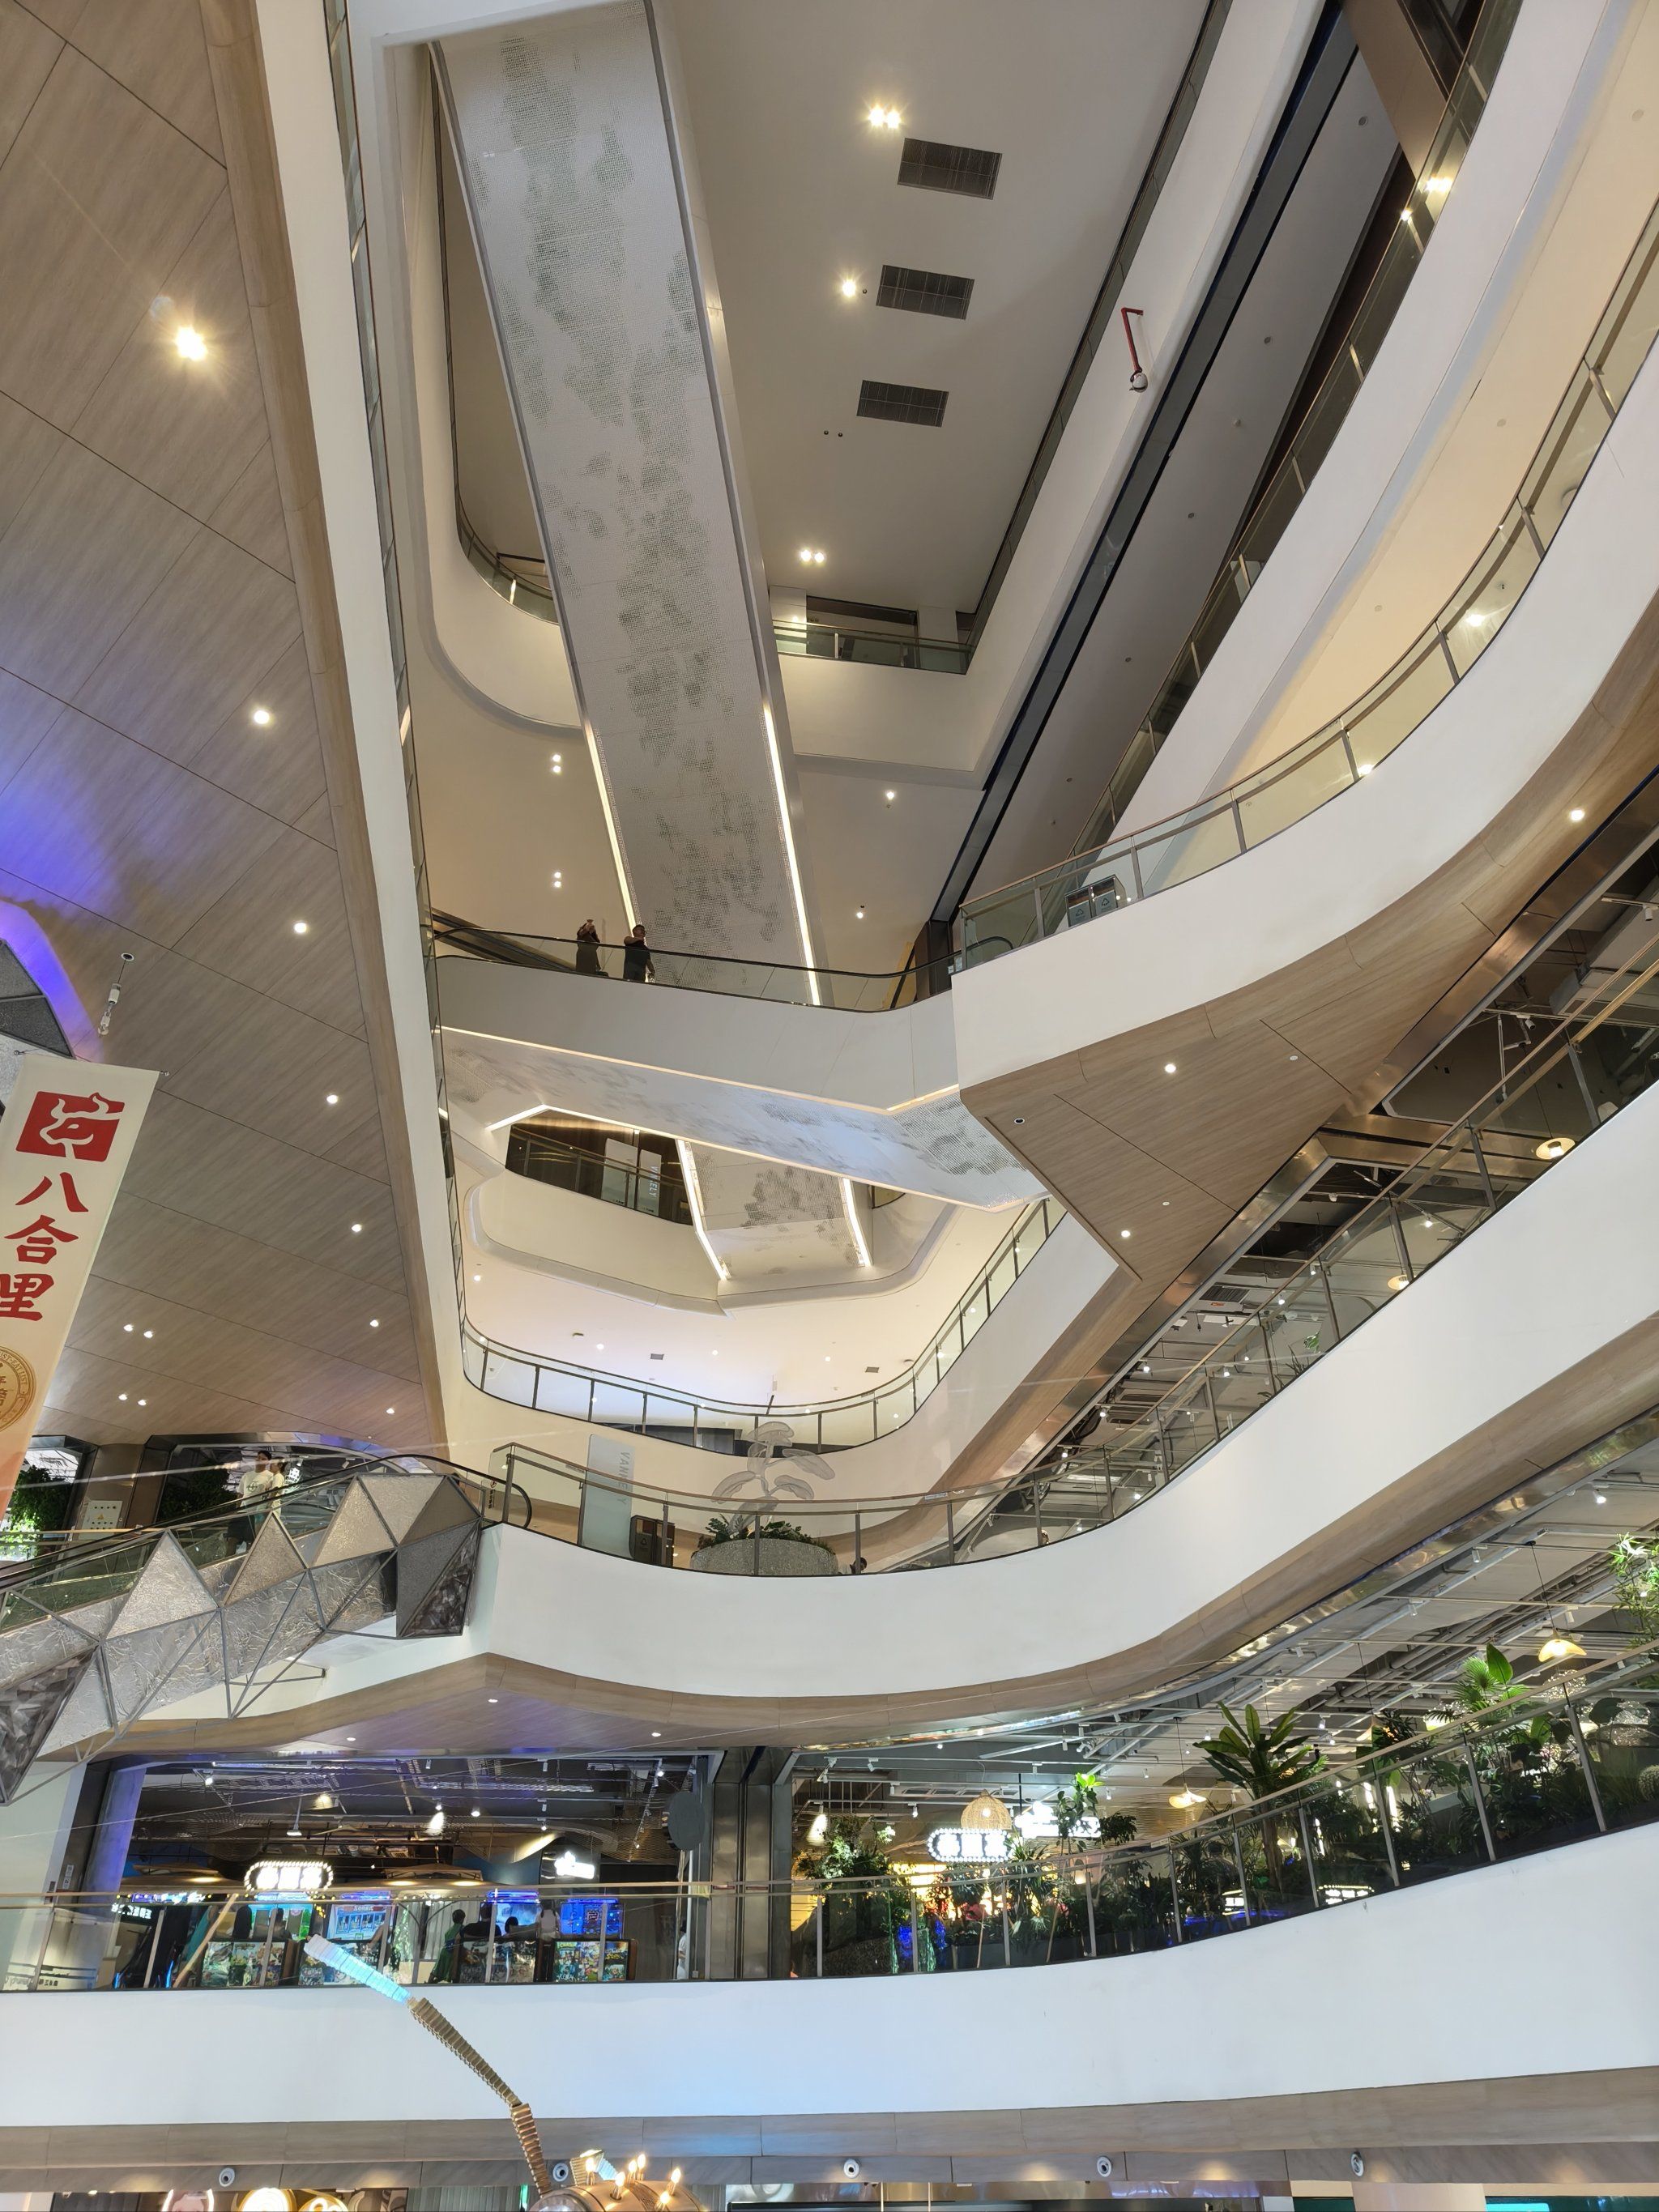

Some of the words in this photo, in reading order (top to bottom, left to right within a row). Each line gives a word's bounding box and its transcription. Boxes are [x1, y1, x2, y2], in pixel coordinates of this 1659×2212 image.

[0, 1172, 88, 1321] 八合里
[617, 1451, 630, 1504] VANEY
